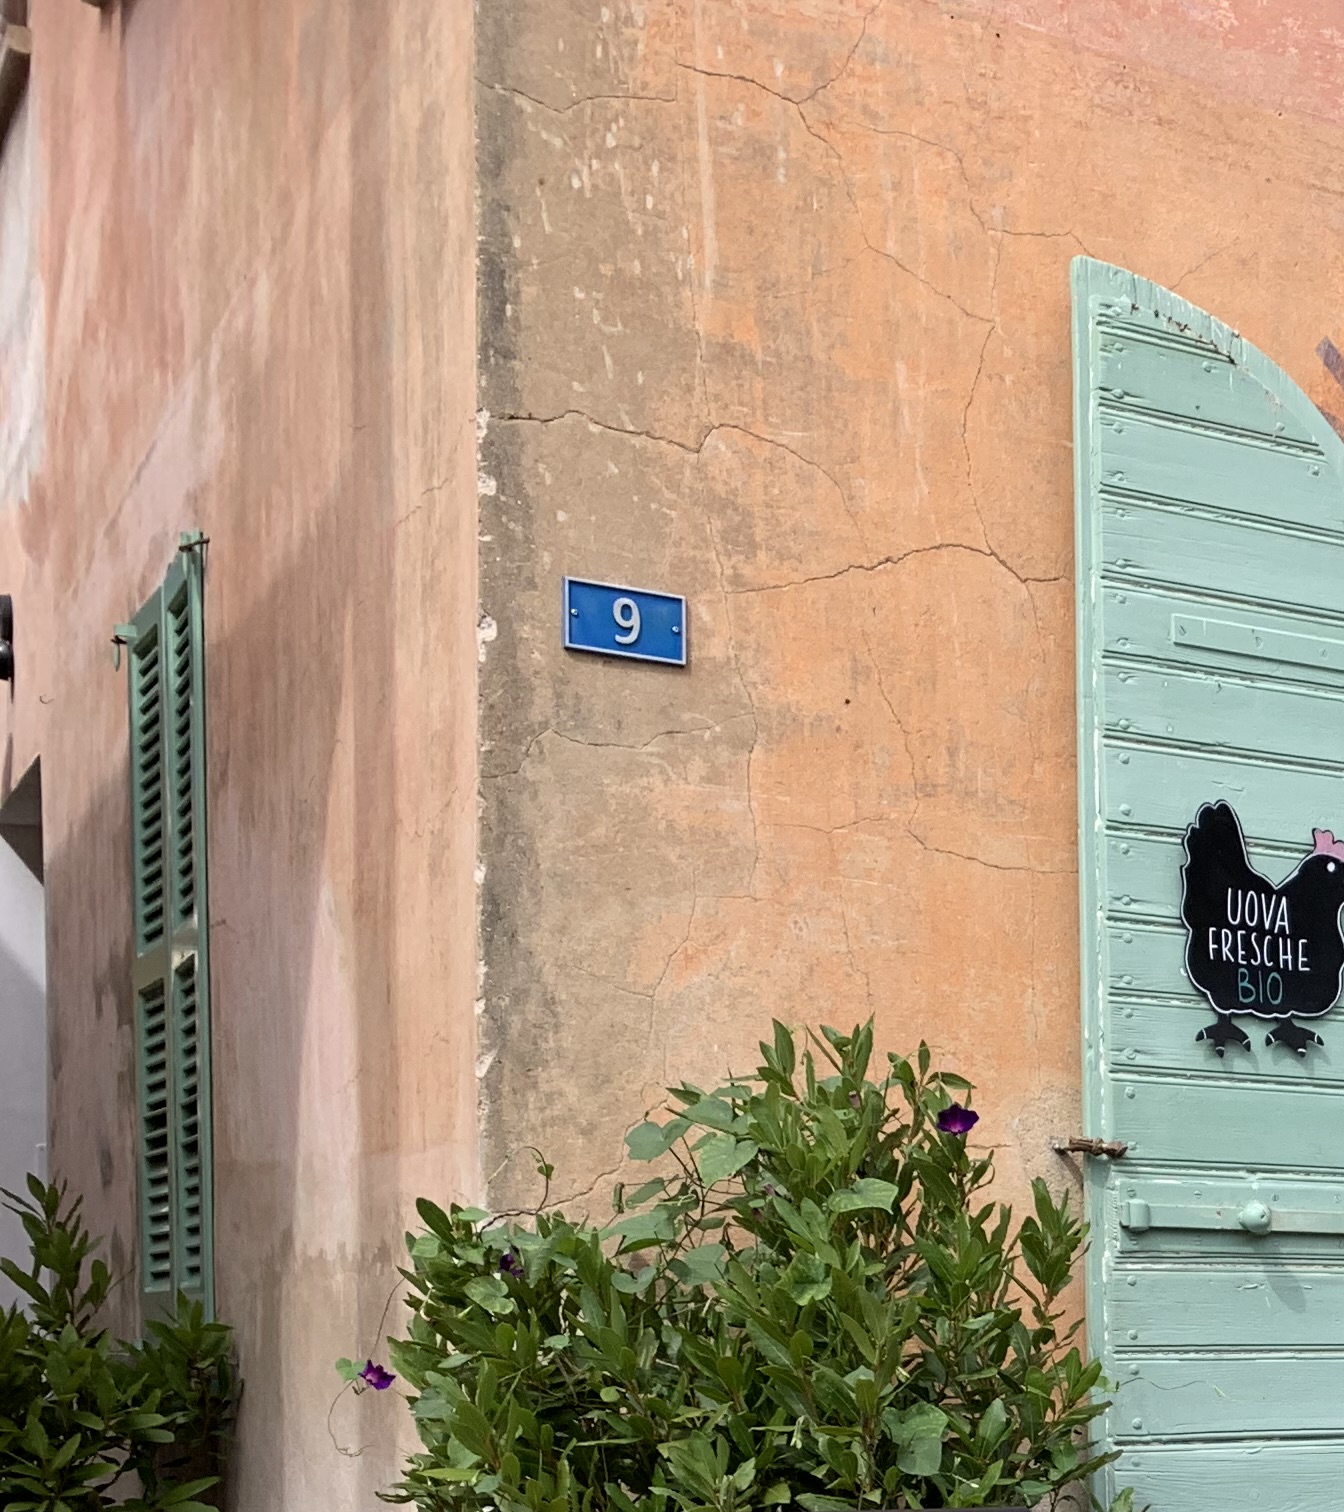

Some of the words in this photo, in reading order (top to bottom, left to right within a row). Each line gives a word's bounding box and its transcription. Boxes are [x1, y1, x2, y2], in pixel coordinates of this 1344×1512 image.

[613, 597, 641, 645] 9
[1227, 887, 1290, 935] UOVA
[1208, 926, 1311, 972] FRESCHE
[1237, 967, 1283, 1005] BIO
